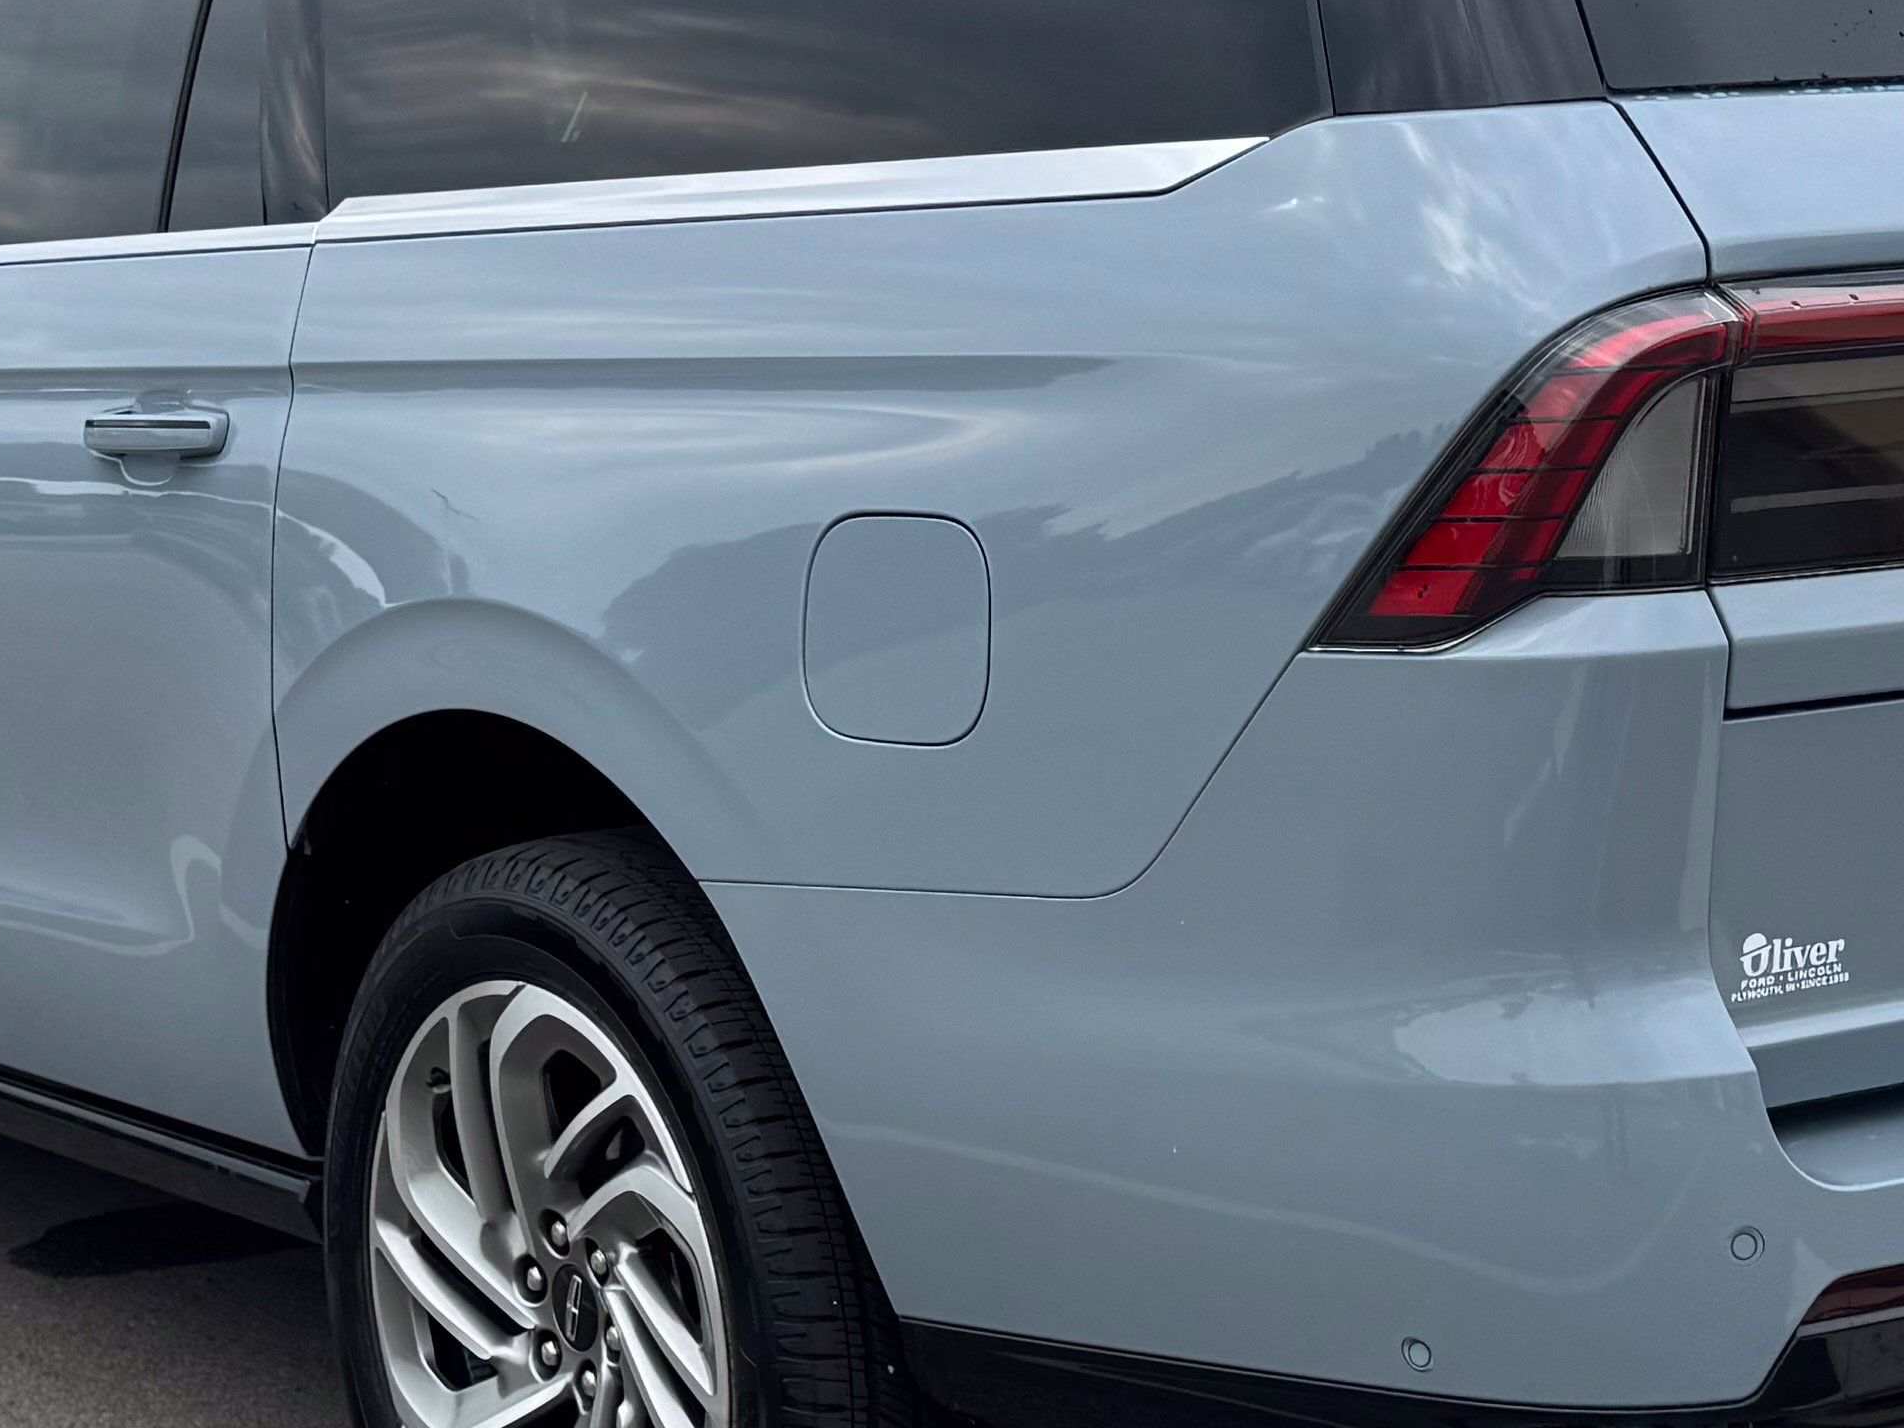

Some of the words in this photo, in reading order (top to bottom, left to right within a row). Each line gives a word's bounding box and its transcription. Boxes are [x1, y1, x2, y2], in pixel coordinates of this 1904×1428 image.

[1740, 933, 1845, 977] Oliver
[1740, 975, 1775, 991] FORD
[1787, 962, 1842, 982] LINCOLN
